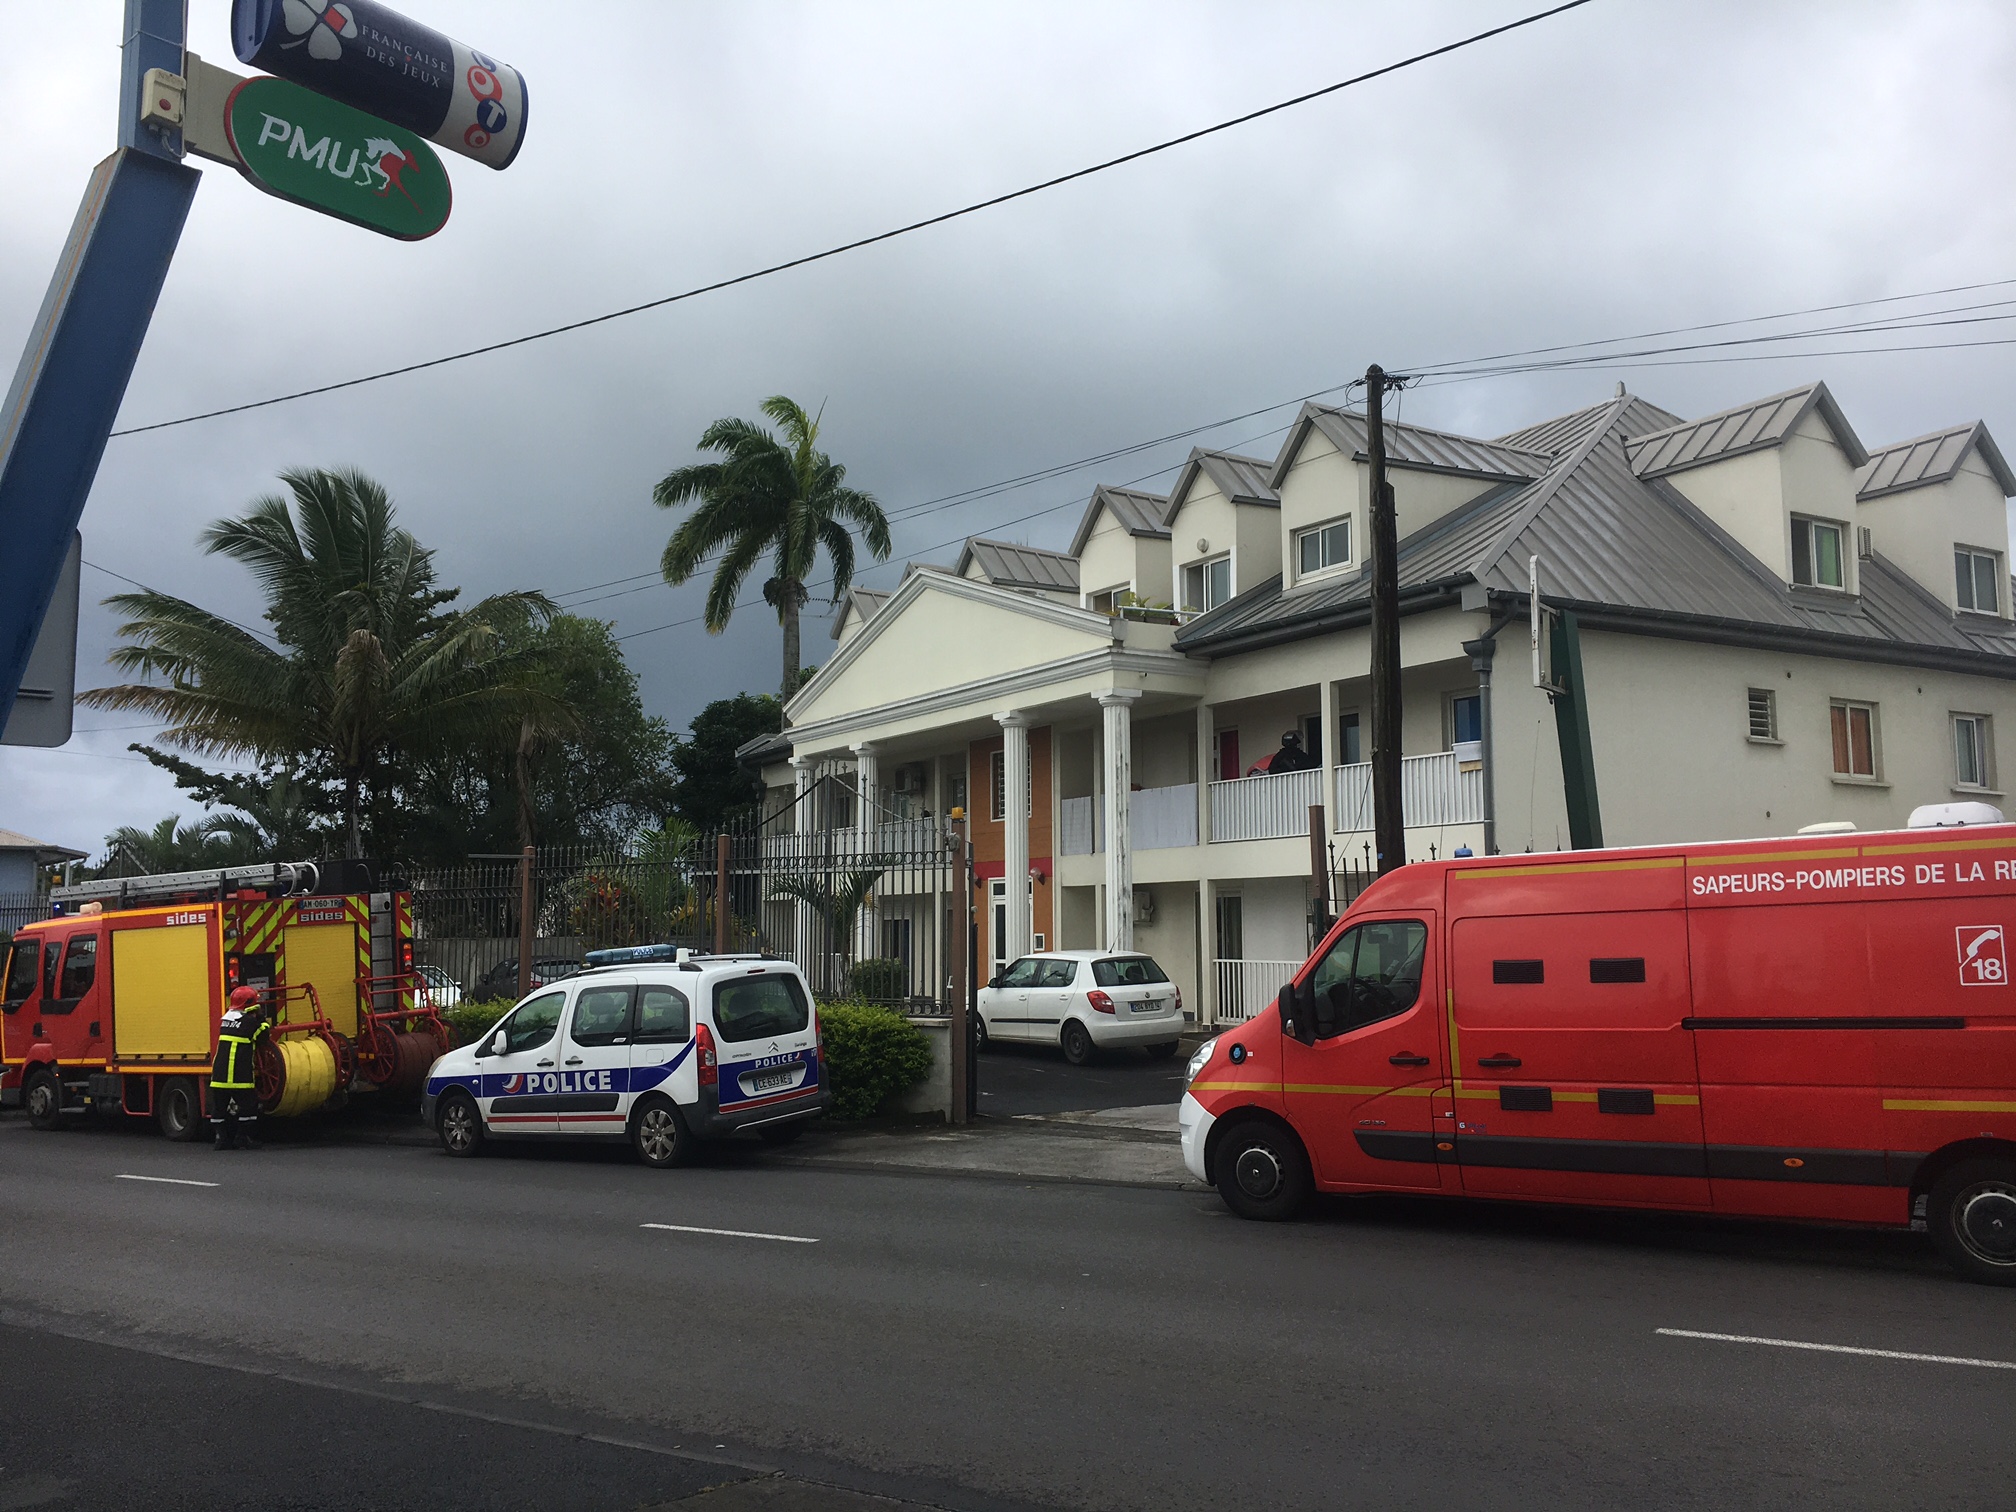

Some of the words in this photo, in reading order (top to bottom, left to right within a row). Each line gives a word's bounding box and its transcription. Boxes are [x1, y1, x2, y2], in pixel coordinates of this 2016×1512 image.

[366, 46, 396, 68] DES
[402, 62, 441, 89] JEUX
[258, 111, 360, 179] PMU
[1692, 864, 1906, 896] SAPEURS-POMPIERS
[1915, 863, 1946, 885] DE
[1954, 861, 1986, 882] LA
[166, 912, 207, 926] sides
[300, 911, 343, 922] sides
[1971, 957, 2002, 982] 18
[755, 1053, 793, 1069] POLICE
[526, 1070, 612, 1093] POLICE
